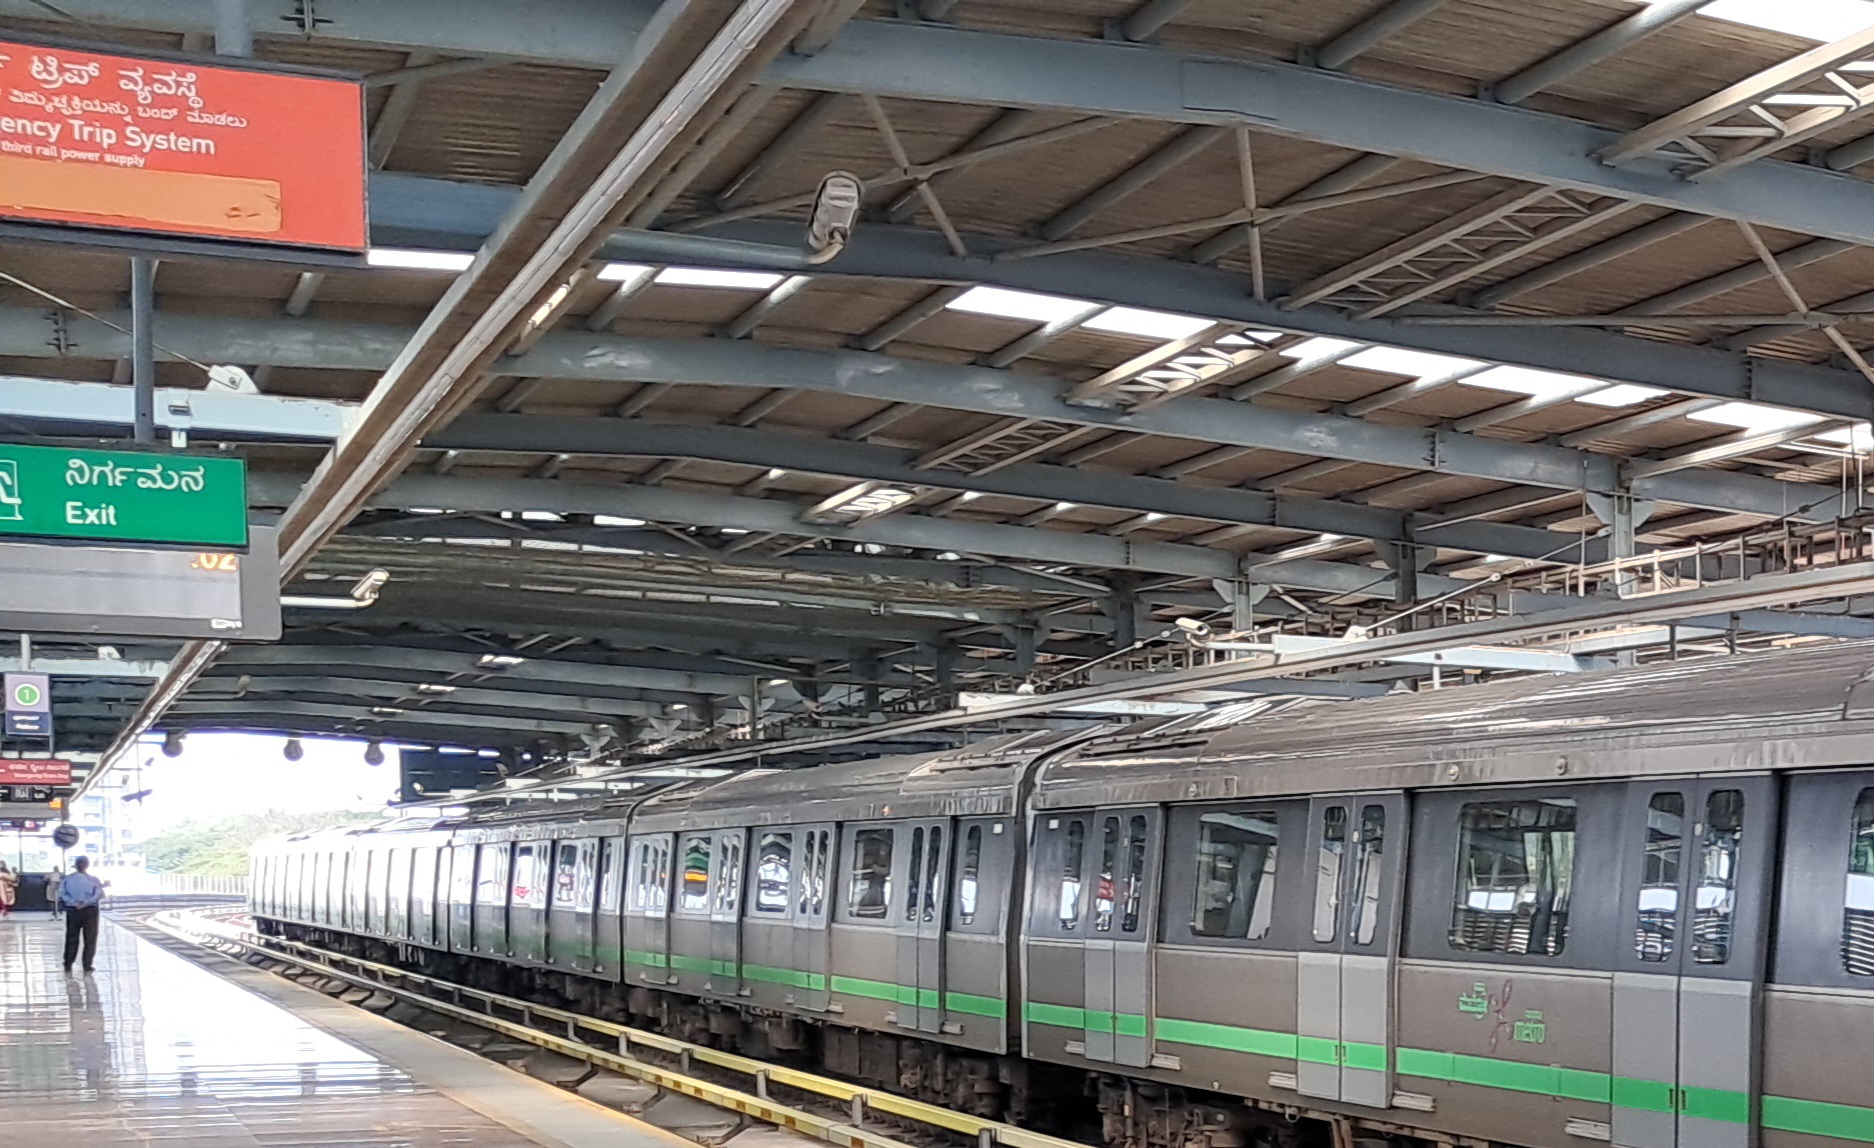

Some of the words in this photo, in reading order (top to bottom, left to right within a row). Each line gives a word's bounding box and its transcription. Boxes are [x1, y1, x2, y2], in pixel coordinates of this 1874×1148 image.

[0, 116, 62, 142] ency
[68, 119, 117, 149] Trip
[124, 125, 216, 155] System
[35, 145, 57, 159] rail
[60, 147, 101, 161] power
[104, 151, 146, 168] supply
[65, 458, 205, 492] ನಿರ್ಗಮನ
[65, 501, 118, 526] Exit
